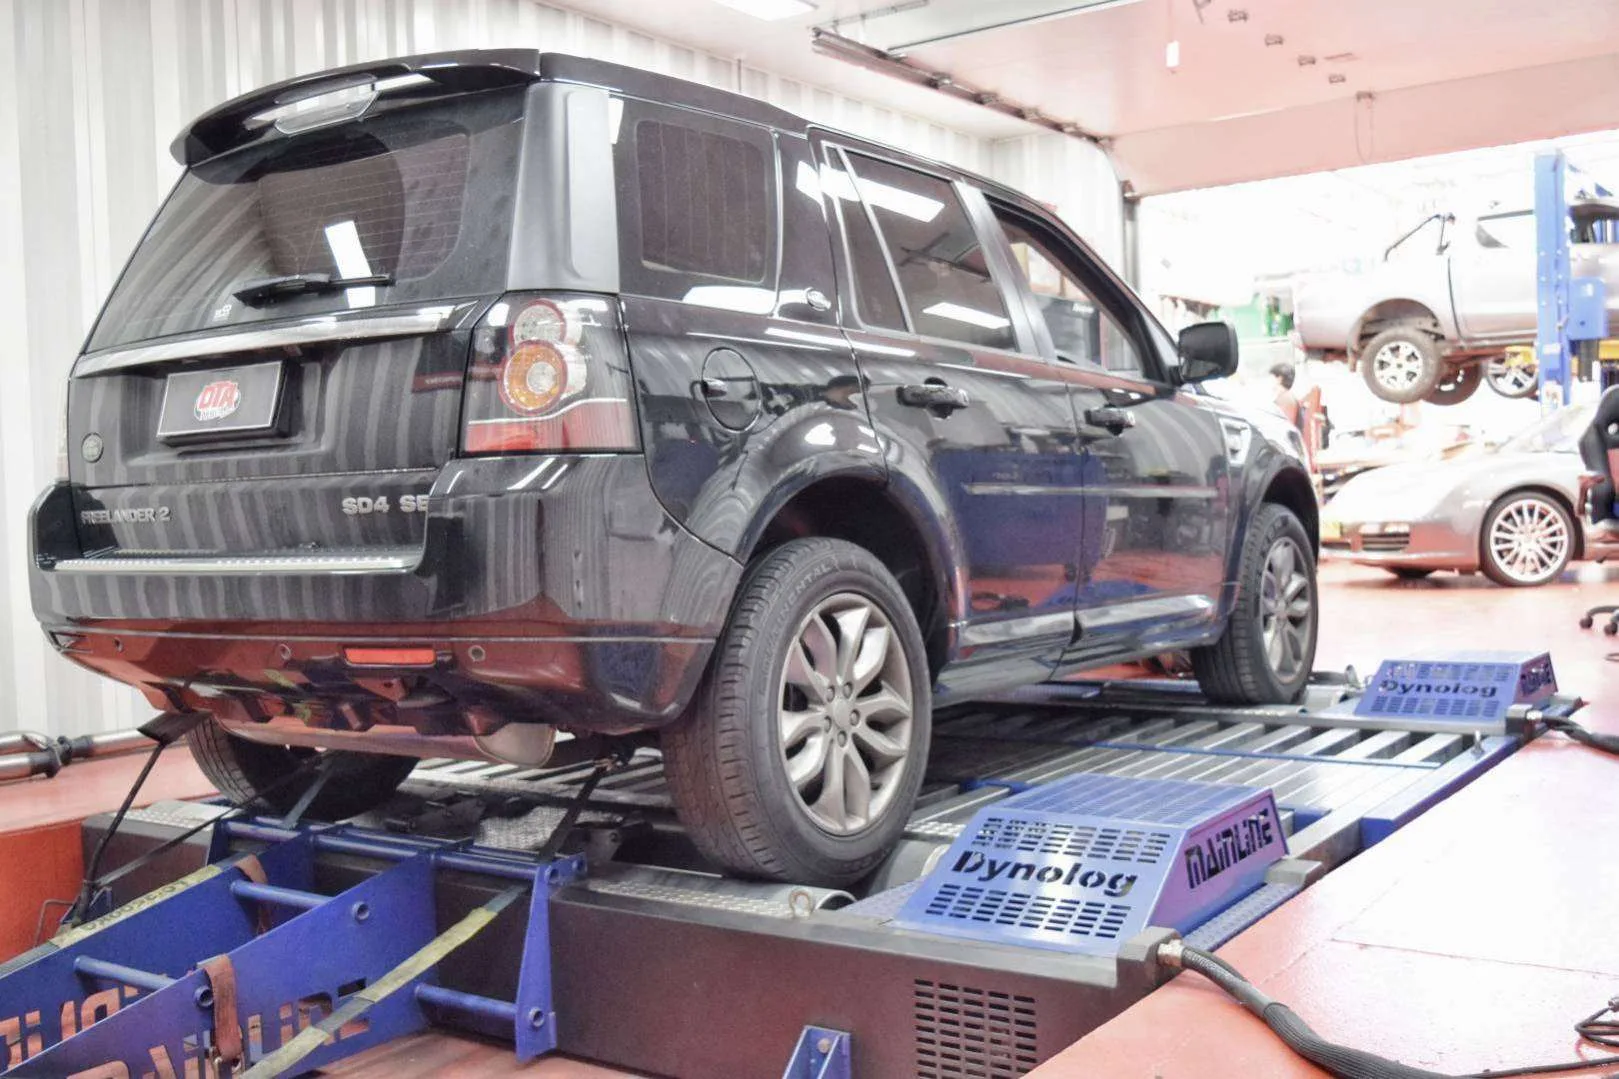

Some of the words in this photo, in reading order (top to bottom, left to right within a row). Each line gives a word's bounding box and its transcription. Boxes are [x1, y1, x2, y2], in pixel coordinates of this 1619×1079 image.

[160, 506, 171, 521] 2
[342, 496, 389, 514] SD4
[400, 494, 429, 512] SE
[1380, 679, 1497, 698] Dynolog
[952, 850, 1138, 897] Dynolog
